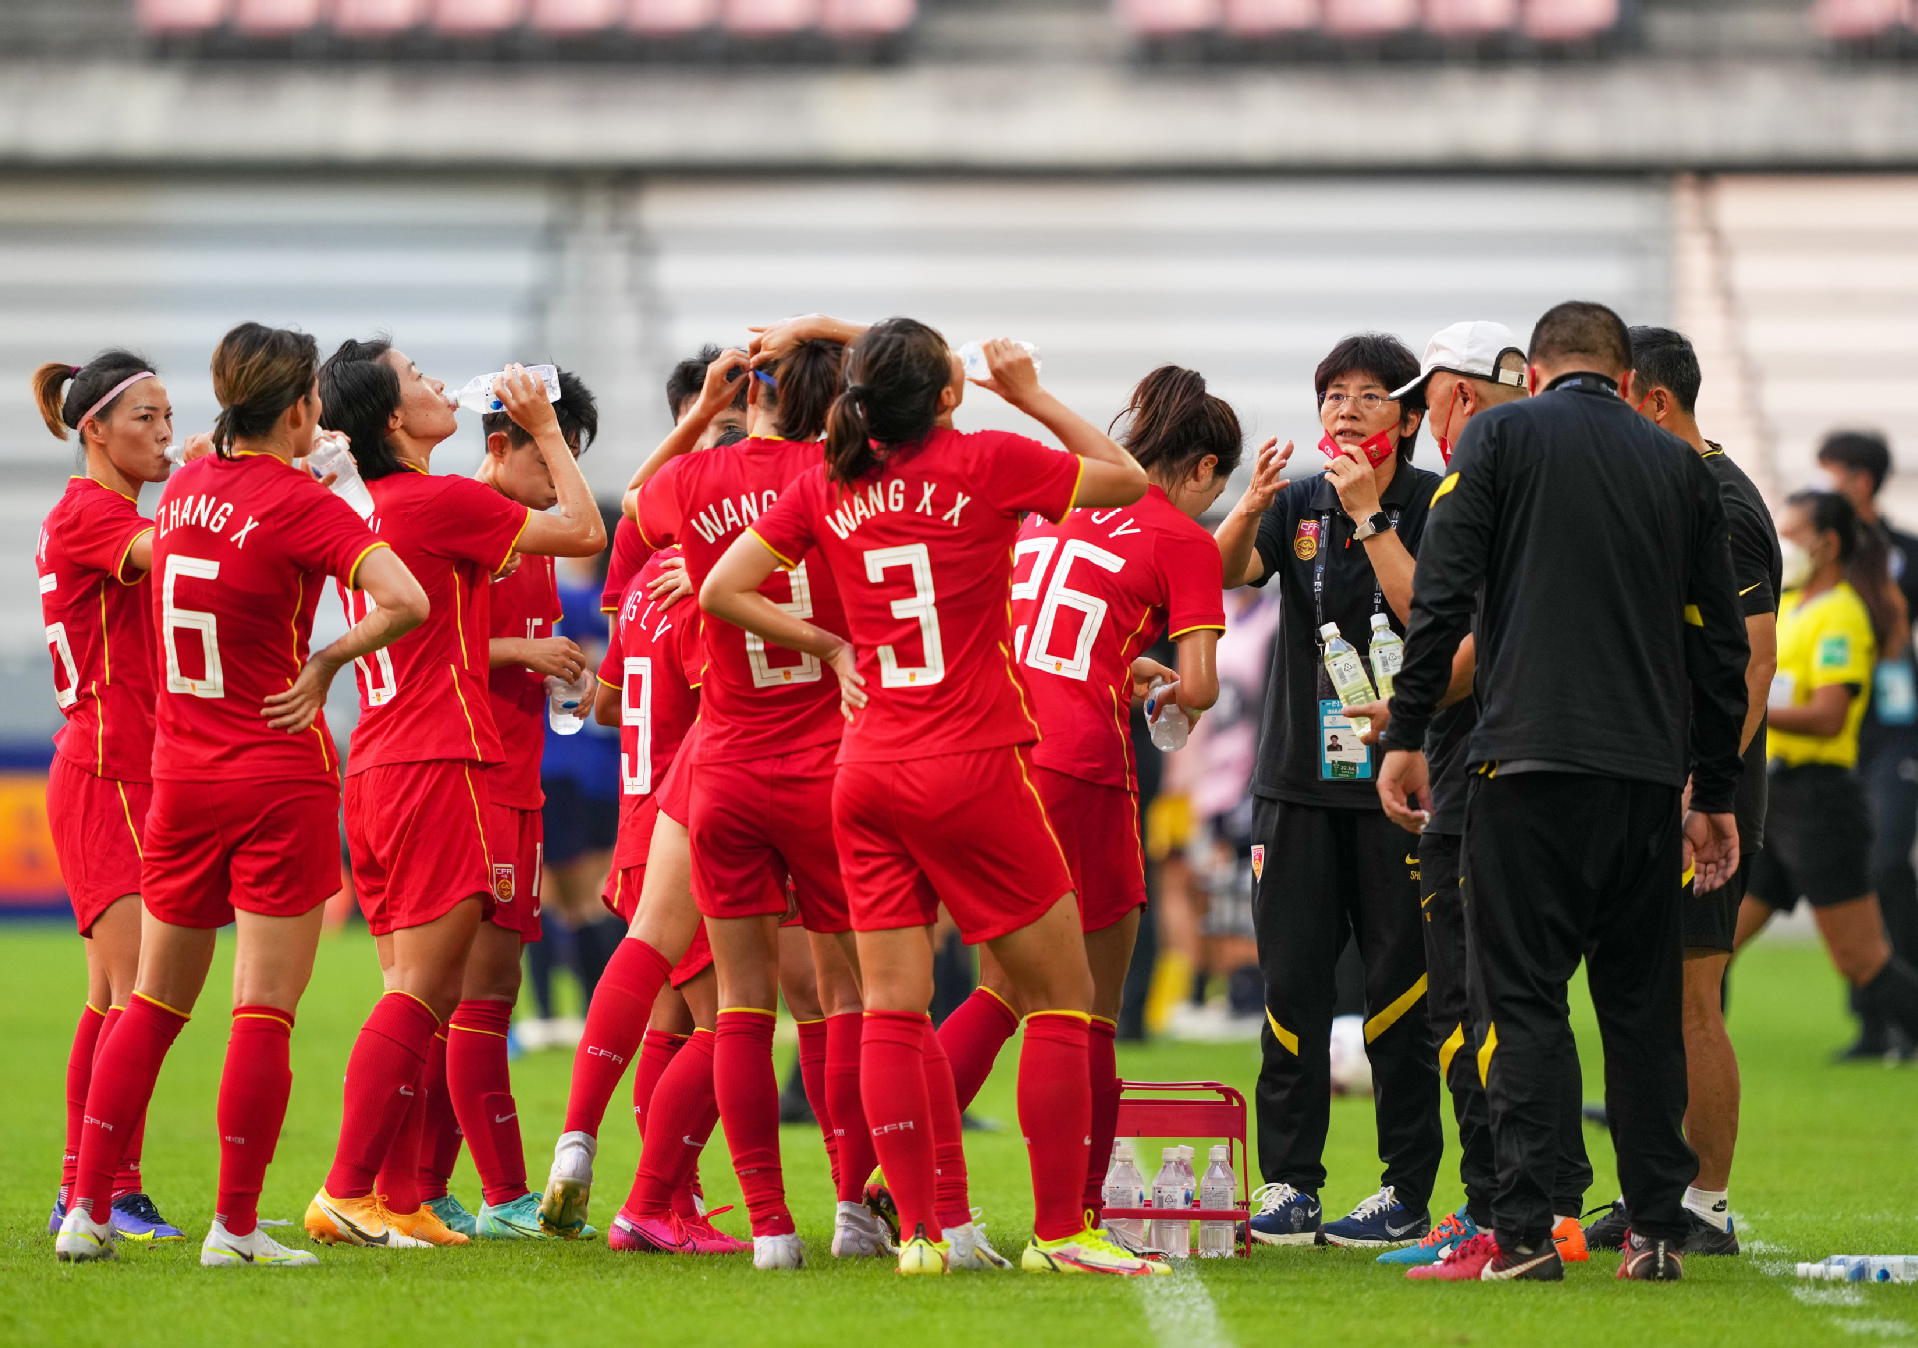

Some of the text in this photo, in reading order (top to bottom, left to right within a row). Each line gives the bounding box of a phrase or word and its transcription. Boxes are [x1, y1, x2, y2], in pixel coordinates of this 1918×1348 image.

[158, 494, 259, 549] ZHANG X
[825, 478, 971, 540] WANG X X
[1108, 518, 1142, 539] Y
[163, 554, 225, 698] 6
[651, 614, 672, 643] Y
[863, 543, 945, 688] 3
[1012, 536, 1127, 682] 26
[621, 656, 652, 795] 9
[587, 1045, 624, 1065] CFA
[84, 1115, 113, 1132] CFA
[872, 1120, 915, 1137] CFA
